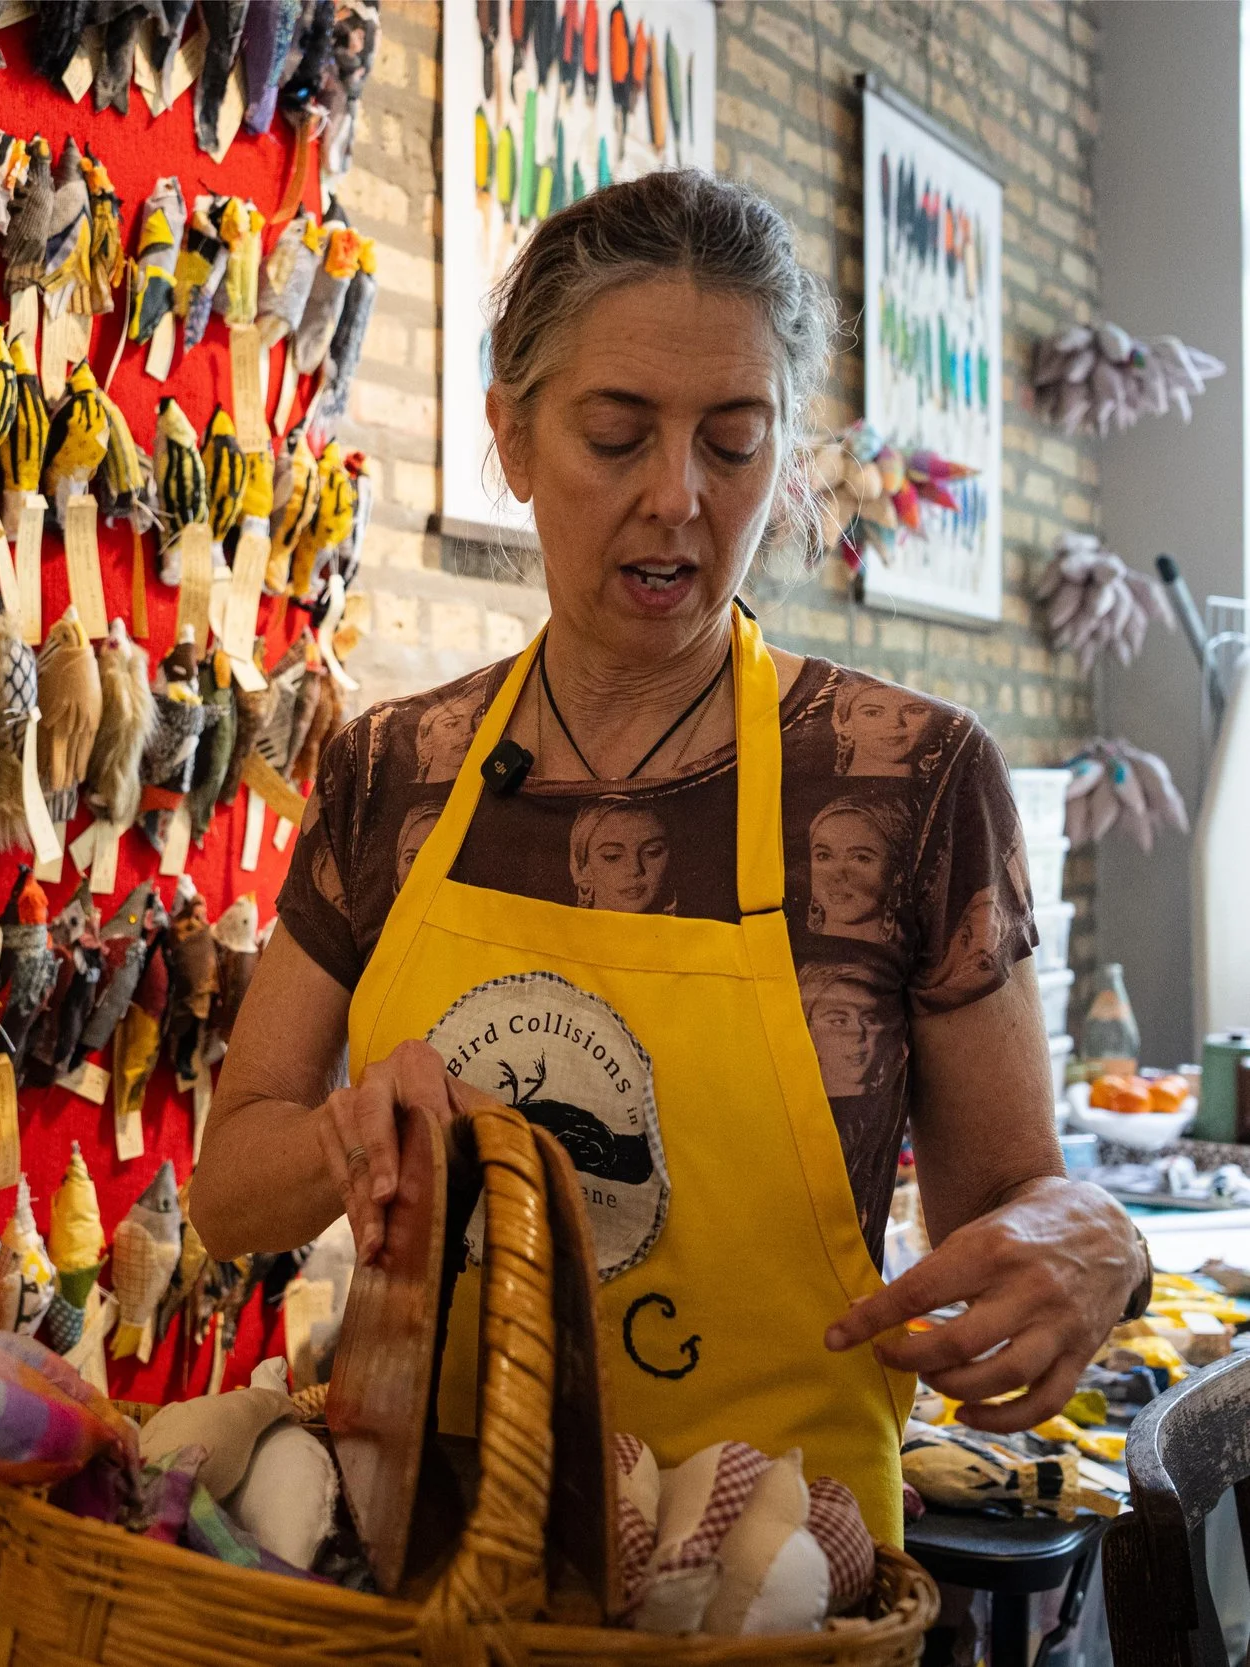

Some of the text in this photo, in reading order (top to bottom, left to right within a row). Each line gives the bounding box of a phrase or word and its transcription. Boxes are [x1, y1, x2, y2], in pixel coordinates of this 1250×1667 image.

[446, 1012, 638, 1126] Bird Collisions in
